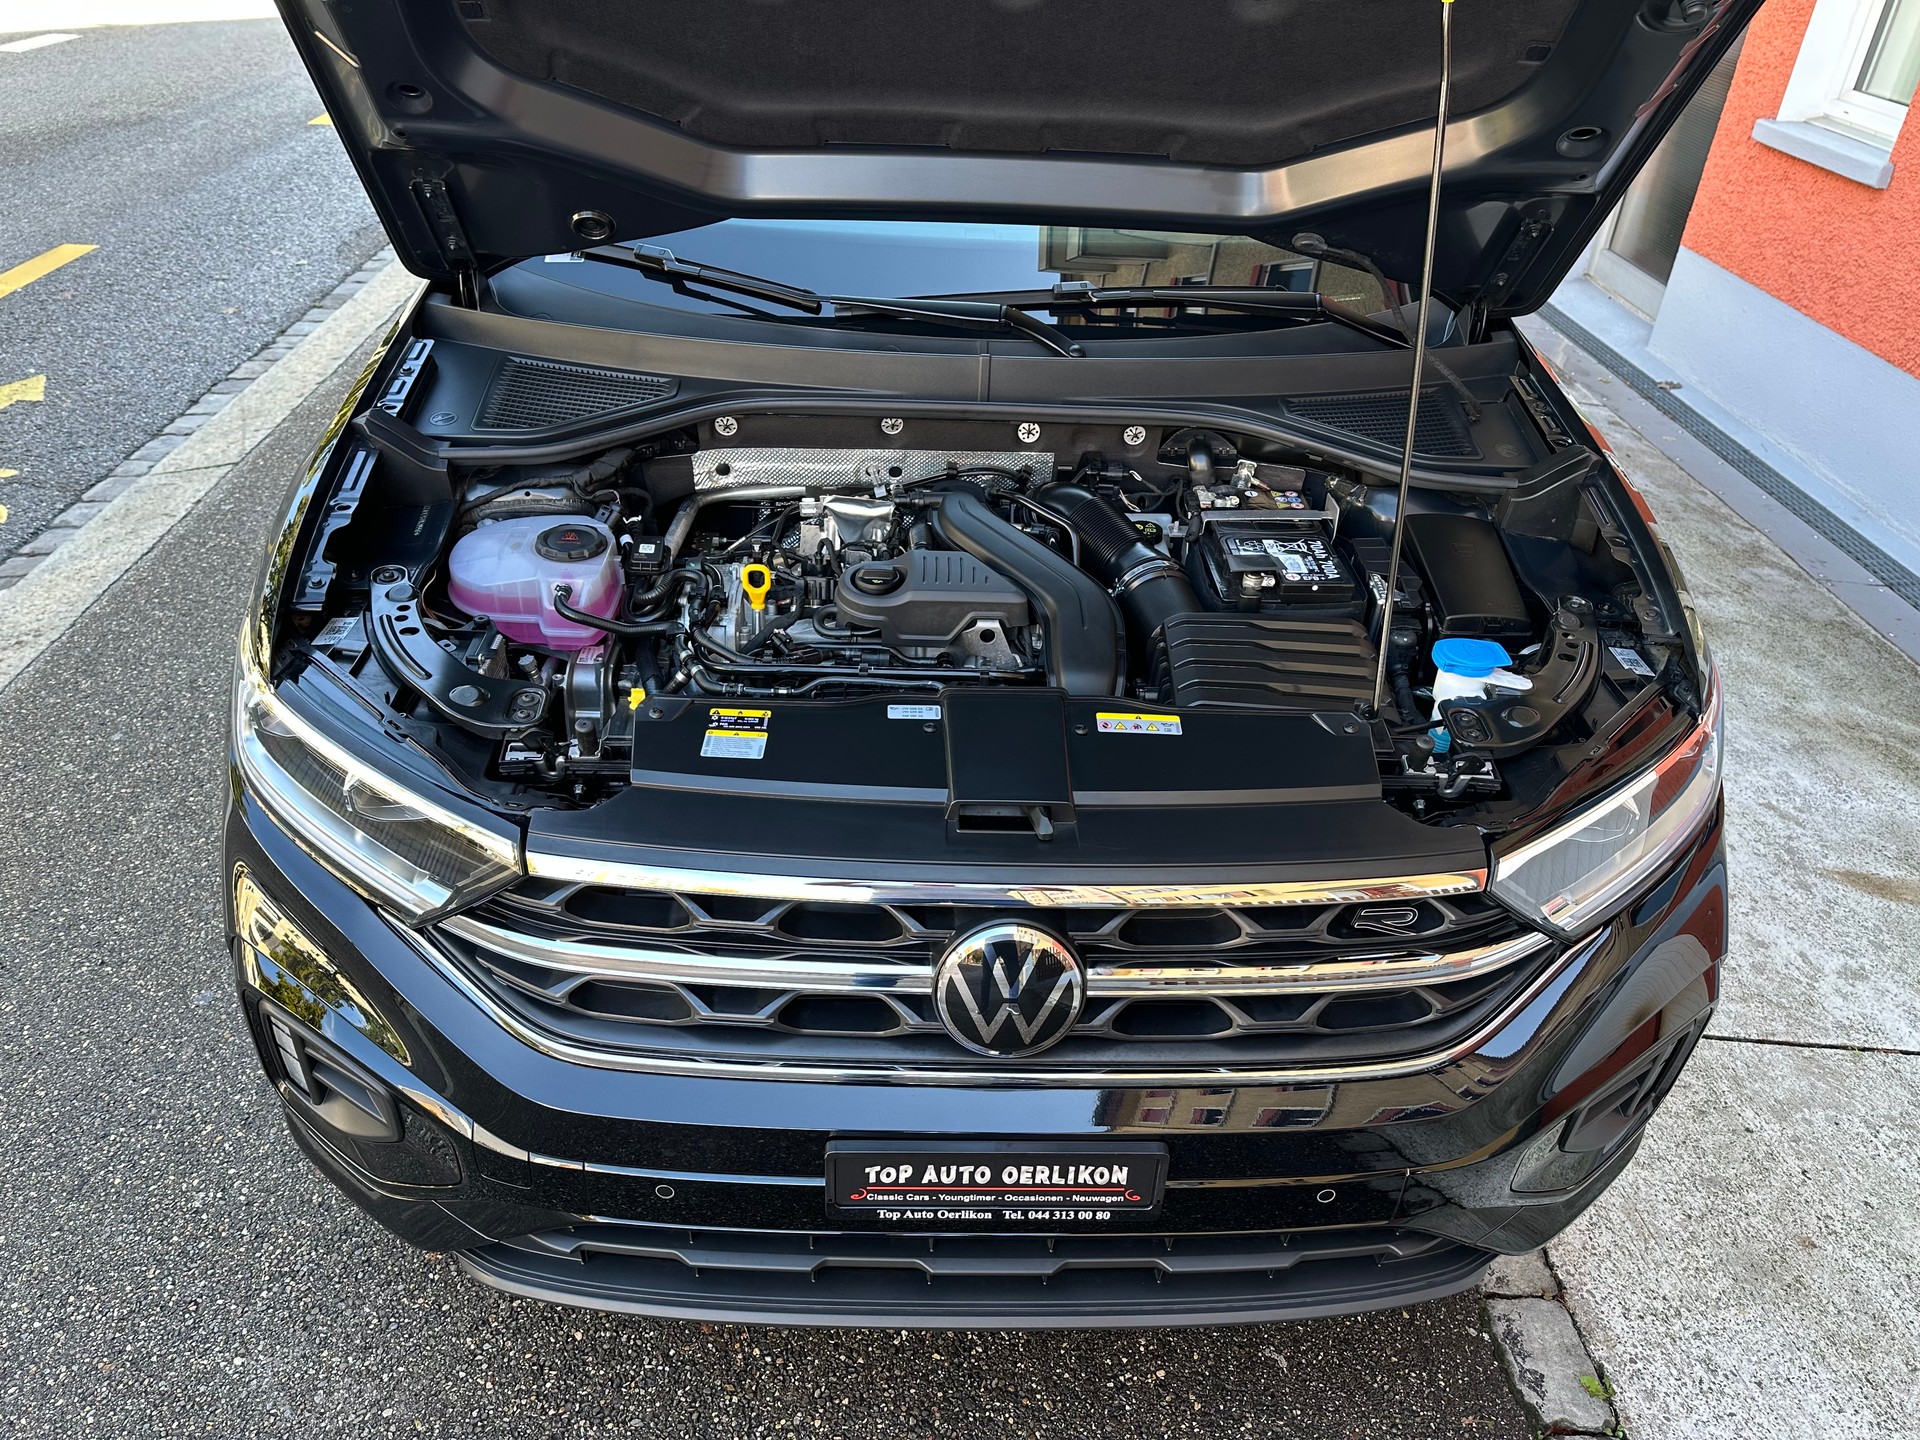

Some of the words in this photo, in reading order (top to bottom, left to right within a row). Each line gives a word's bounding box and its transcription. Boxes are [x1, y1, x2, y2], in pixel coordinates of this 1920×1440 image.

[1308, 541, 1328, 558] 70Ah
[1319, 560, 1340, 579] 700A
[944, 935, 1078, 1048] VW
[864, 1164, 913, 1184] TOP
[921, 1165, 992, 1184] AUTO
[1001, 1165, 1129, 1185] OERLIKON
[866, 1193, 904, 1201] Classic
[906, 1193, 930, 1201] Cars
[938, 1193, 996, 1203] Youngtimer
[1004, 1194, 1064, 1202] Occasionen
[1072, 1194, 1124, 1203] Neuwagen
[877, 1209, 901, 1220] Top
[903, 1209, 934, 1219] Auto
[937, 1209, 993, 1219] Oerlikon
[1002, 1210, 1025, 1220] Tel.
[1028, 1210, 1050, 1220] 044
[1053, 1210, 1075, 1220] 313
[1078, 1210, 1093, 1220] 00
[1095, 1210, 1111, 1220] 80
